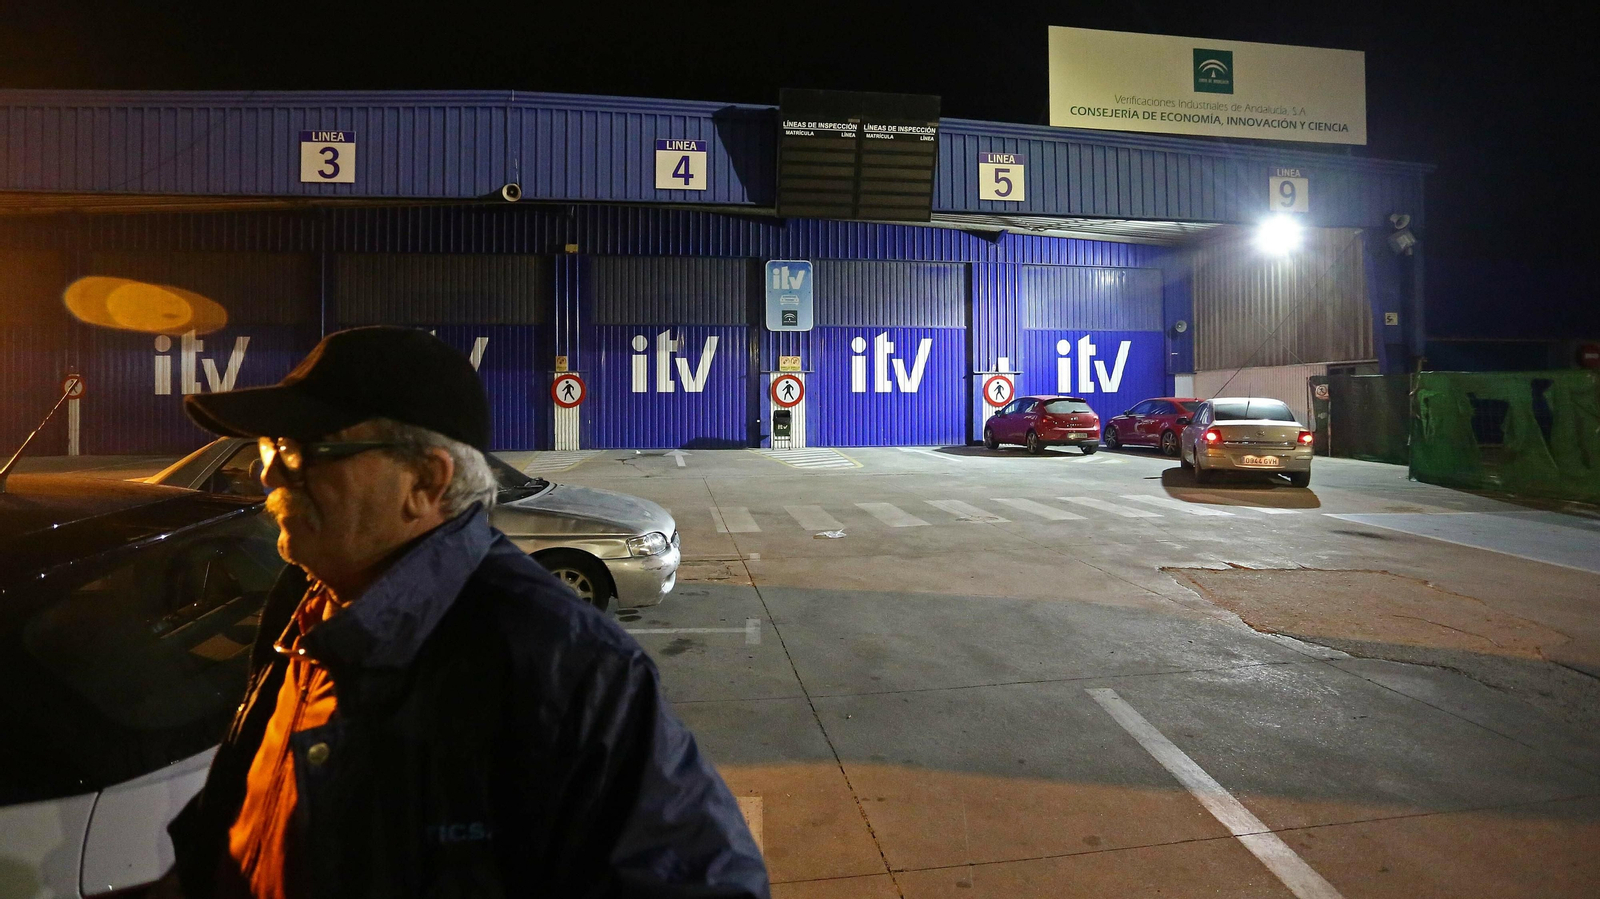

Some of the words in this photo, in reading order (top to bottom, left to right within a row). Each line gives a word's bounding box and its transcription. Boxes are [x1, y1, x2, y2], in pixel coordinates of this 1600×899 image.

[1115, 95, 1175, 108] Verificaciones
[1178, 99, 1228, 111] Industriales
[1231, 103, 1242, 112] de
[783, 120, 806, 128] LÍNEAS
[818, 122, 858, 130] INSPECCIÓN
[864, 123, 887, 131] LÍNEAS
[898, 126, 936, 134] INSPECCIÓN
[1070, 106, 1139, 119] CONSEJERÍA
[1142, 111, 1157, 120] DE
[1160, 112, 1224, 126] ECONOMÍA,
[1226, 116, 1297, 130] INNOVACIÓN
[1299, 121, 1306, 130] Y
[1308, 121, 1349, 132] CIENCIA
[312, 131, 345, 142] LINEA
[666, 140, 697, 151] LINEA
[317, 146, 340, 180] 3
[672, 155, 694, 186] 4
[988, 154, 1016, 164] LINEA
[994, 168, 1013, 198] 5
[1276, 168, 1301, 178] LINEA
[1279, 180, 1297, 208] 9
[772, 266, 806, 290] itv
[154, 329, 251, 395] itv
[631, 328, 720, 393] itv
[851, 331, 933, 393] itv
[1056, 334, 1132, 393] itv
